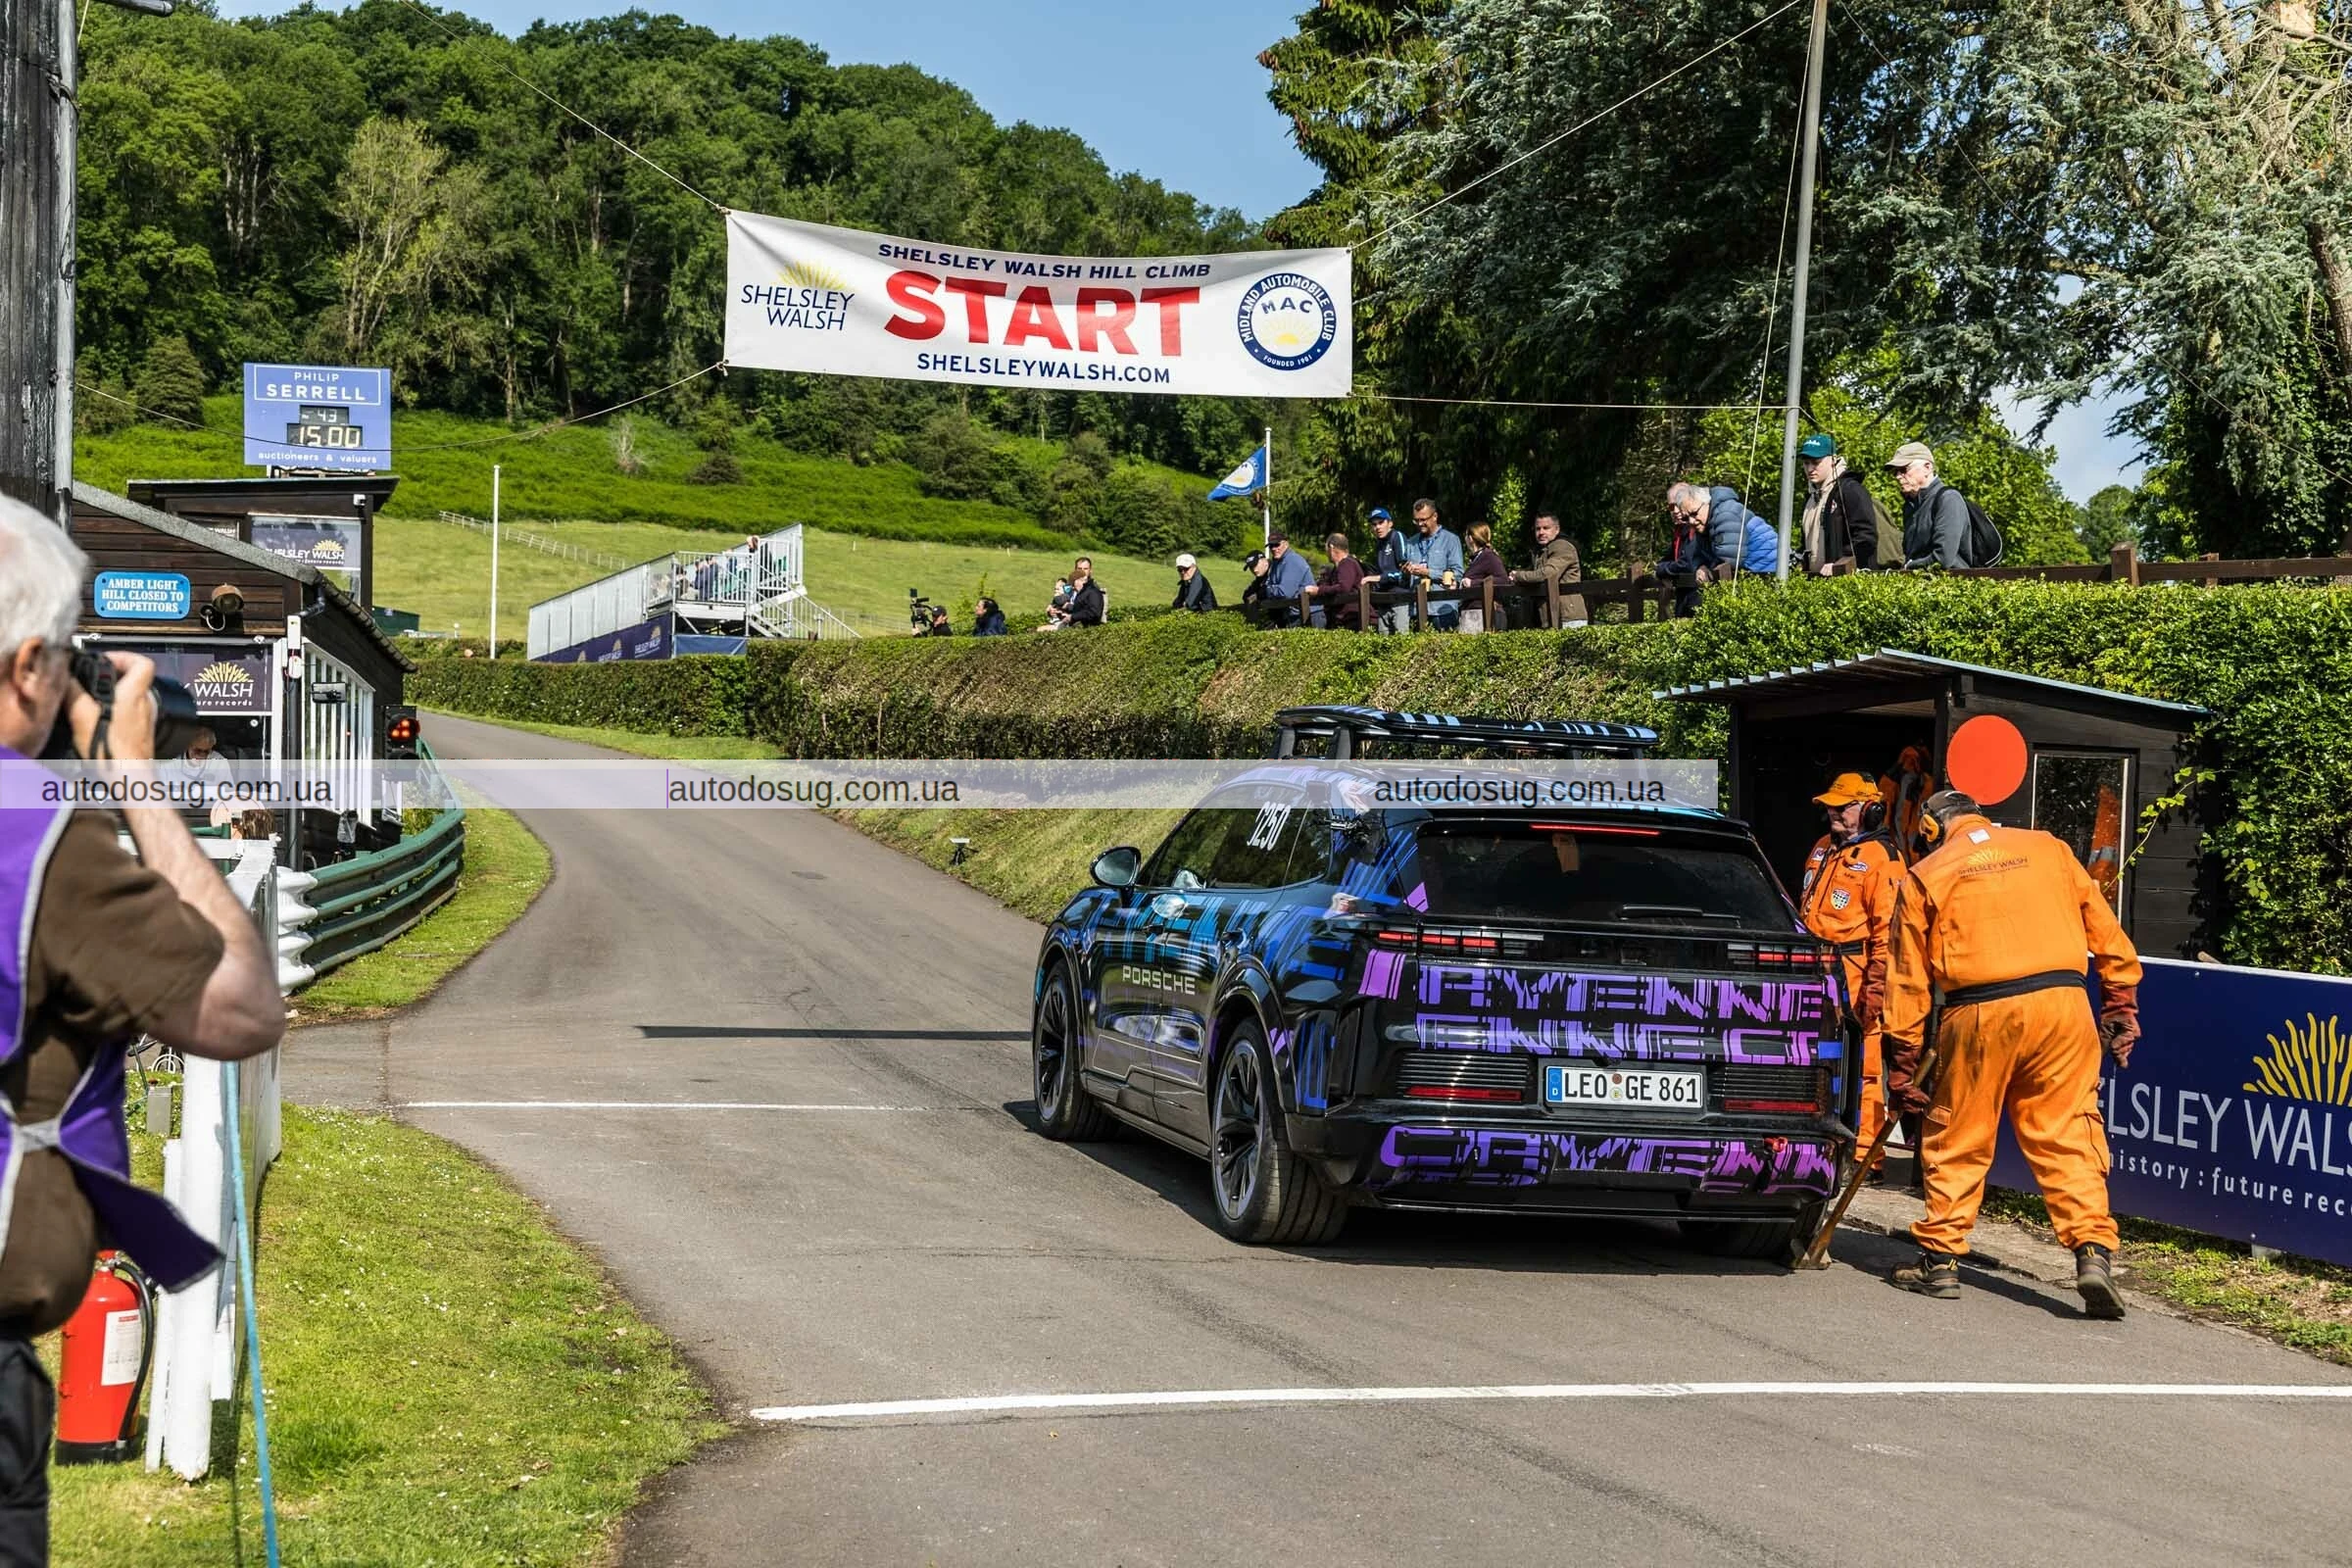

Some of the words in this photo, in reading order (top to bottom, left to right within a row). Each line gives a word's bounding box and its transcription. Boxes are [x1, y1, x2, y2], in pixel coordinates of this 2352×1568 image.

[878, 243, 997, 271] SHELSLEY
[1004, 260, 1082, 279] WALSH
[1089, 265, 1138, 279] HILL
[1145, 264, 1211, 279] CLIMB
[741, 284, 855, 312] SHELSLEY
[1260, 297, 1313, 315] MAC
[884, 269, 1201, 357] START
[1239, 290, 1260, 343] MIDLAND
[1260, 274, 1331, 308] AUTOMOBILE
[1321, 310, 1335, 341] CLUB
[766, 307, 846, 331] WALSH
[917, 353, 1170, 384] SHELSLEYWALSH.COM
[1263, 354, 1295, 368] FOUNDED
[294, 371, 340, 382] PHILIP
[267, 383, 367, 401] SERRELL
[258, 452, 319, 462] auctioneers
[340, 455, 377, 464] valuers
[313, 549, 345, 560] WALSH
[108, 578, 144, 590] AMBER
[147, 579, 178, 591] LIGHT
[101, 589, 125, 600] HILL
[128, 590, 168, 601] CLOSED
[170, 591, 184, 602] TO
[106, 601, 178, 612] COMPETITORS
[194, 683, 253, 698] WALSH
[1999, 856, 2028, 868] WALSH
[1122, 964, 1196, 996] PORSCHE
[1551, 1088, 1558, 1097] D
[1564, 1072, 1607, 1099] LEO
[1625, 1075, 1652, 1101] GE
[1658, 1077, 1698, 1102] 861
[2244, 1099, 2352, 1177] WAL
[2212, 1166, 2293, 1205] future
[2304, 1192, 2352, 1217] rec
